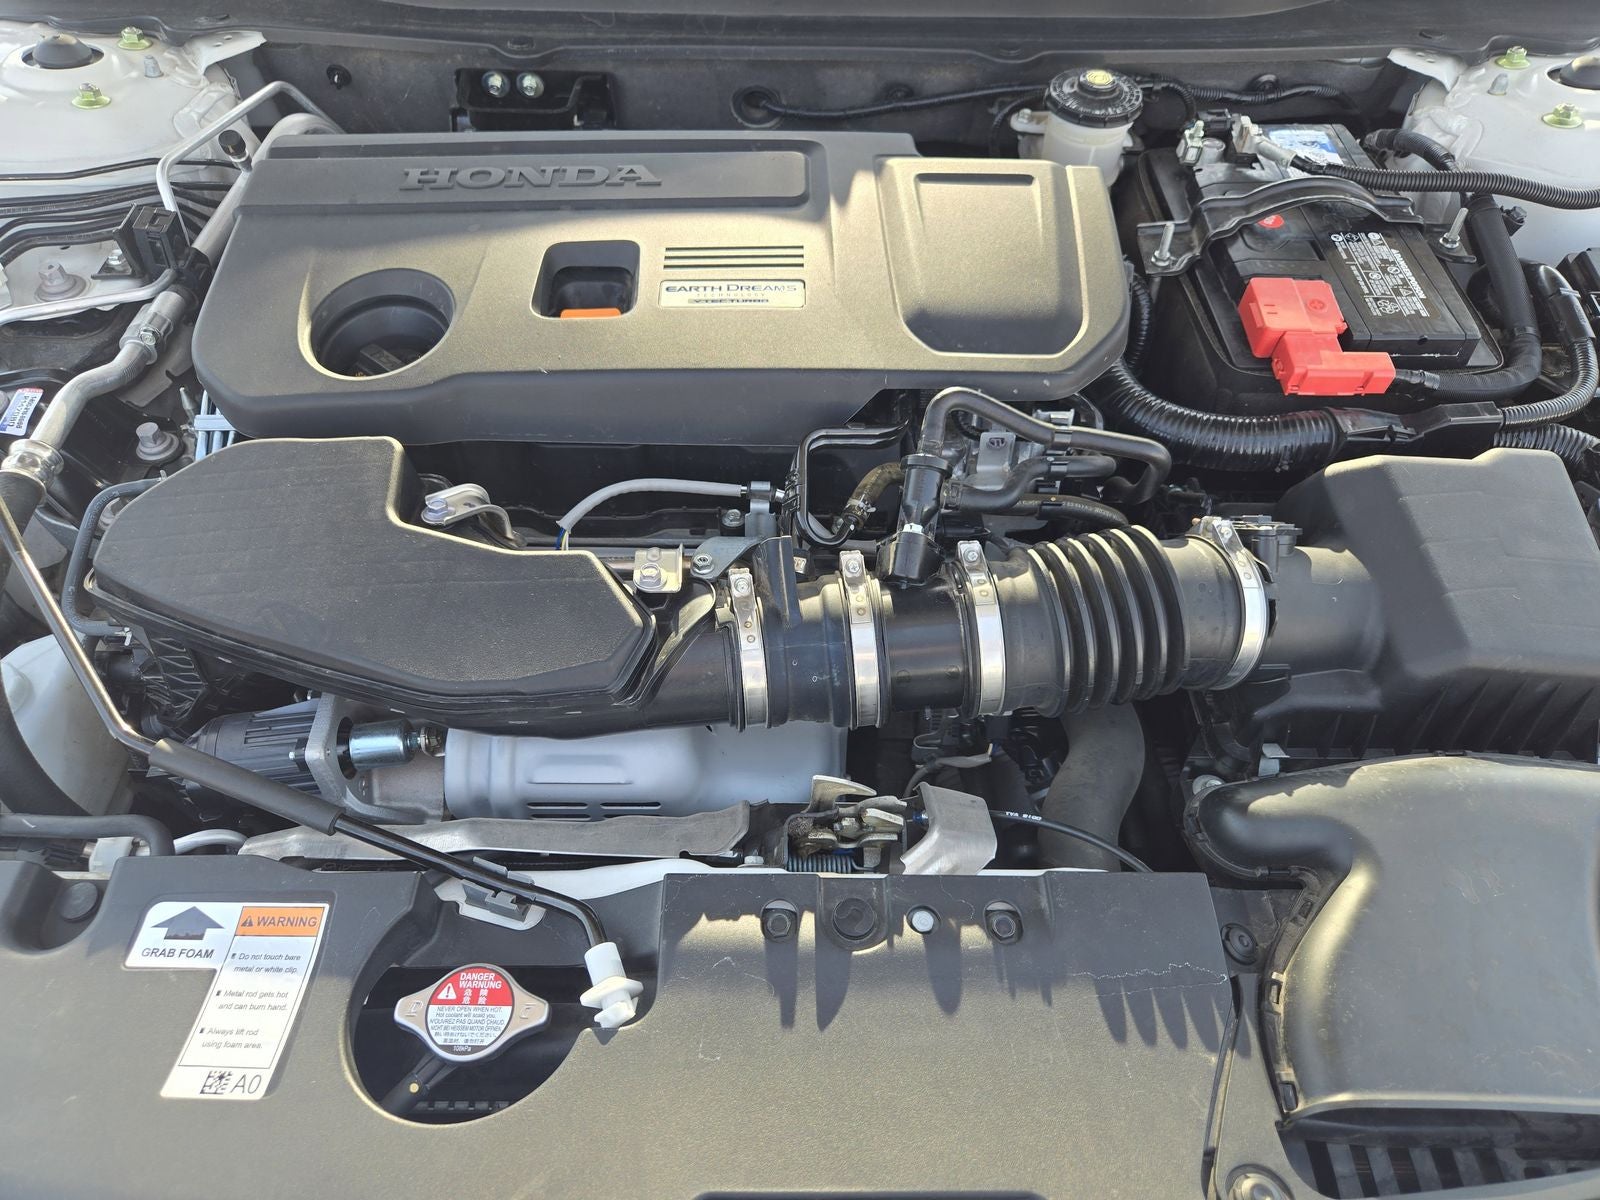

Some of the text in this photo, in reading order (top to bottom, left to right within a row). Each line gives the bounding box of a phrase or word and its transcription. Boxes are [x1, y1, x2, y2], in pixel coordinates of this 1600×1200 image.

[400, 165, 662, 191] HONDA
[727, 284, 797, 293] DREAMS
[257, 916, 317, 927] WARNING
[142, 948, 214, 959] GRAB FOAM
[264, 953, 283, 961] touch
[460, 972, 495, 981] DANGER
[459, 980, 502, 989] WARNUNG
[259, 991, 274, 999] gets
[276, 990, 288, 998] hot
[267, 1003, 287, 1011] hand.
[202, 1041, 221, 1049] using
